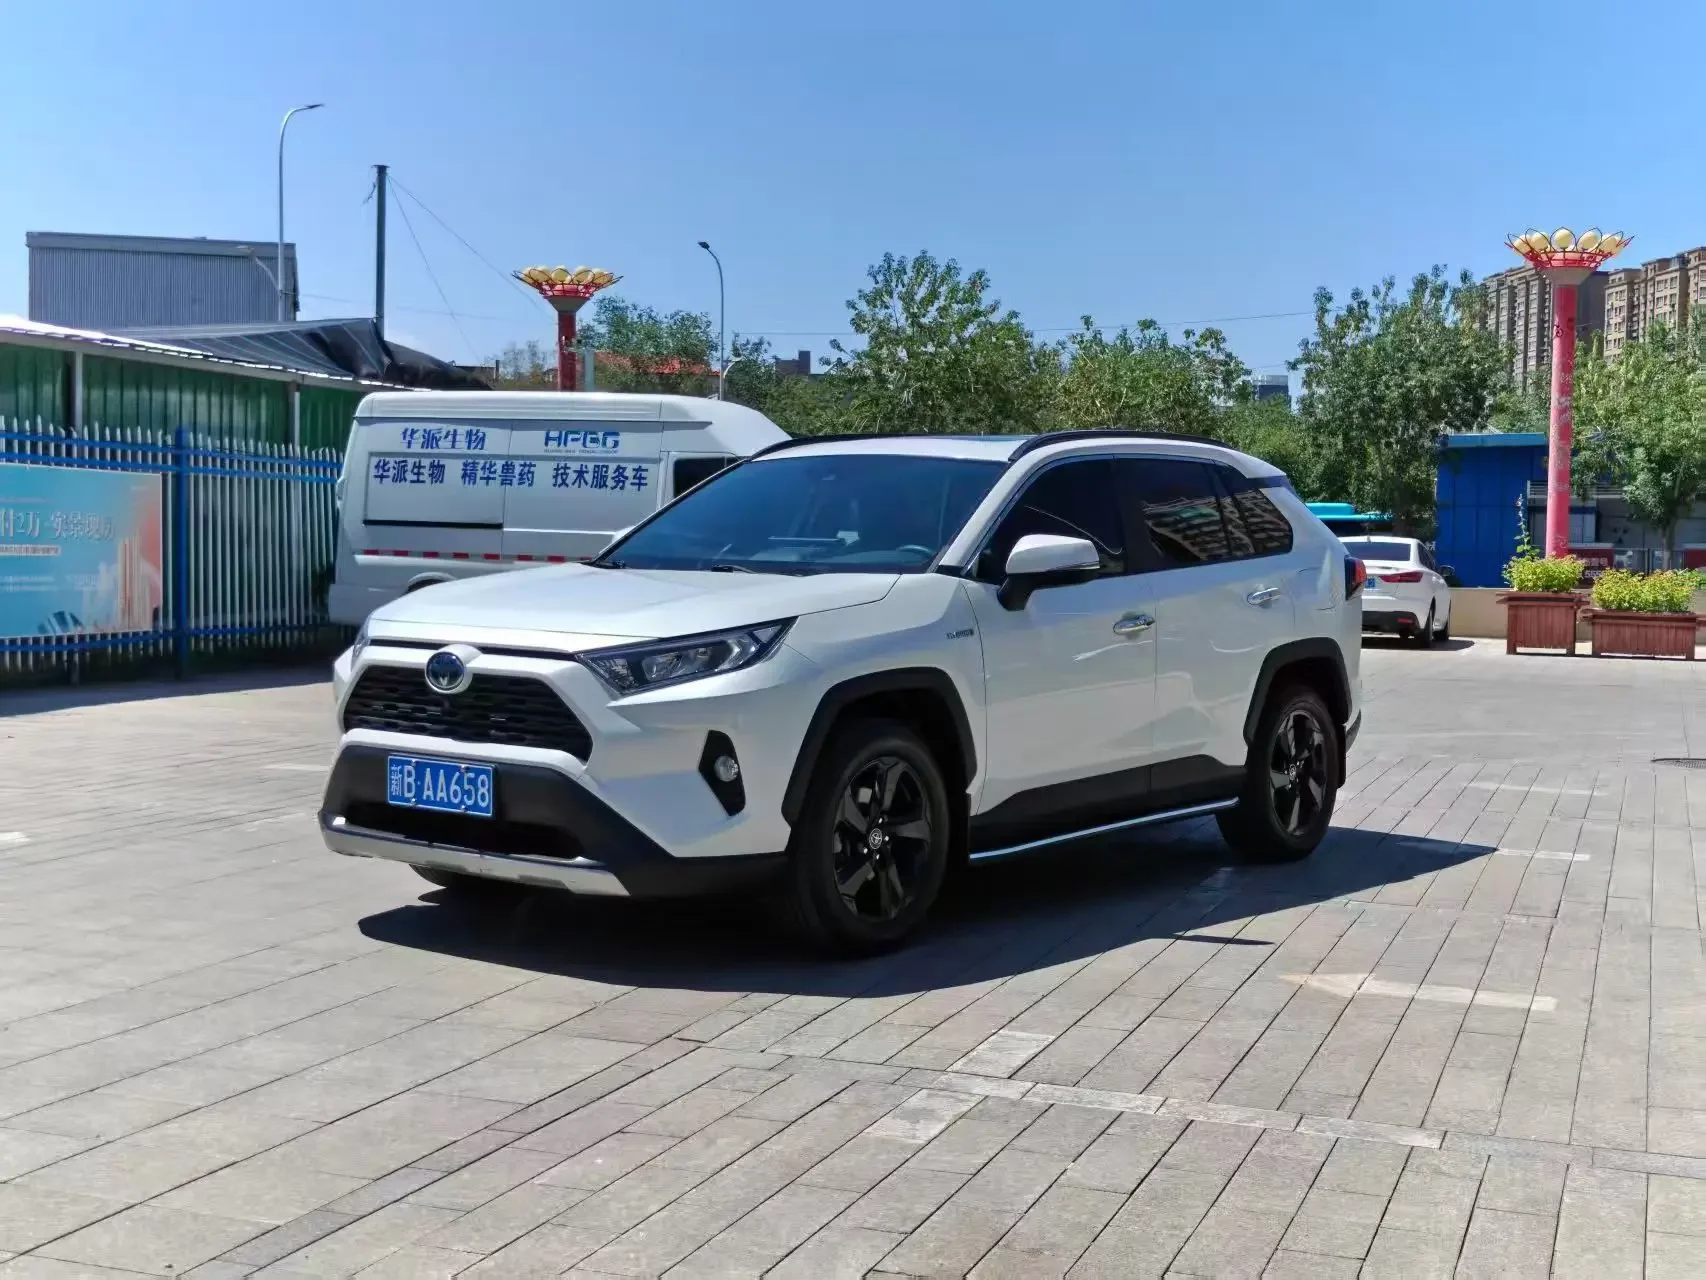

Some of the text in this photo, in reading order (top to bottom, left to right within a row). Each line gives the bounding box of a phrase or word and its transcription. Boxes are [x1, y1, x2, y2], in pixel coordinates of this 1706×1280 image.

[402, 427, 486, 450] 华派生物
[373, 458, 649, 492] 华派生物 精华兽药 技术服务车
